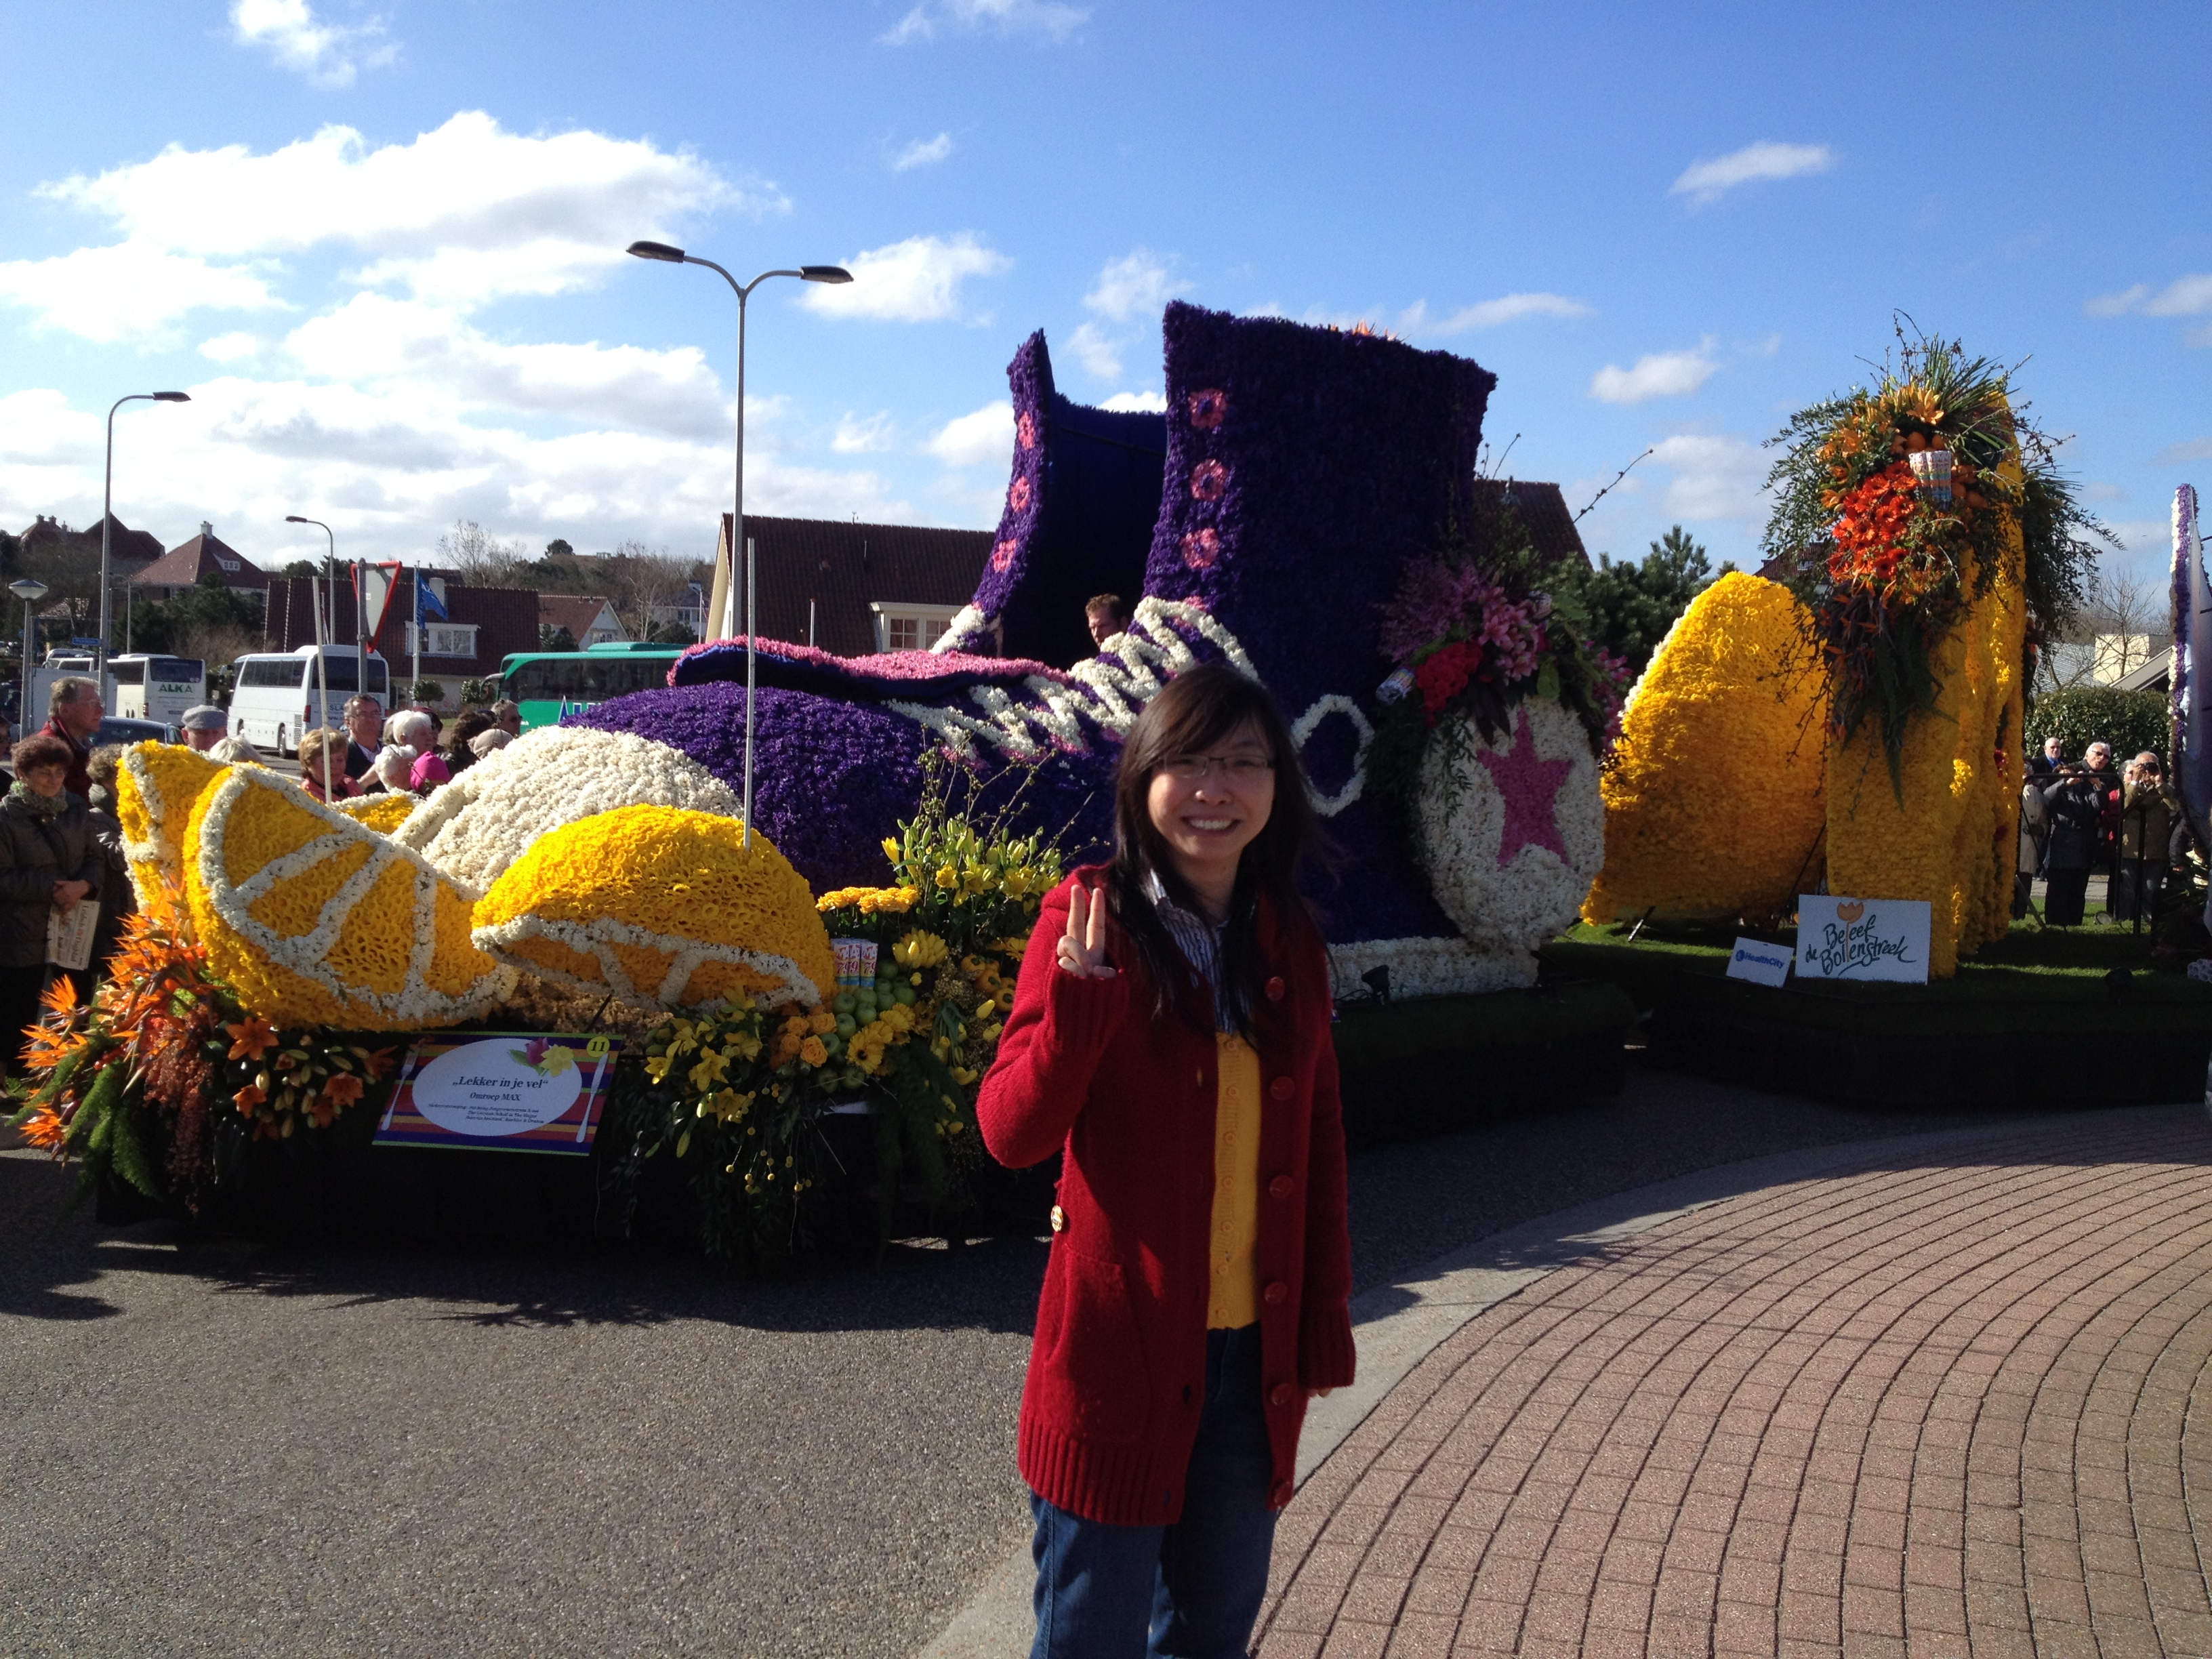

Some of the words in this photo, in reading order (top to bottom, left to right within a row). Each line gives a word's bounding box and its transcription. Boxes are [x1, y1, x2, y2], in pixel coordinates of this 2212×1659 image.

[158, 683, 193, 693] ALKA
[1823, 914, 1877, 947] Beleef
[1744, 951, 1784, 969] HealthCity
[1805, 943, 1818, 963] de
[1820, 935, 1917, 976] Bollenstreek
[590, 1041, 606, 1052] 11
[499, 1077, 511, 1087] in
[510, 1078, 523, 1089] je
[470, 1092, 500, 1101] Omroep
[500, 1093, 521, 1101] MAX
